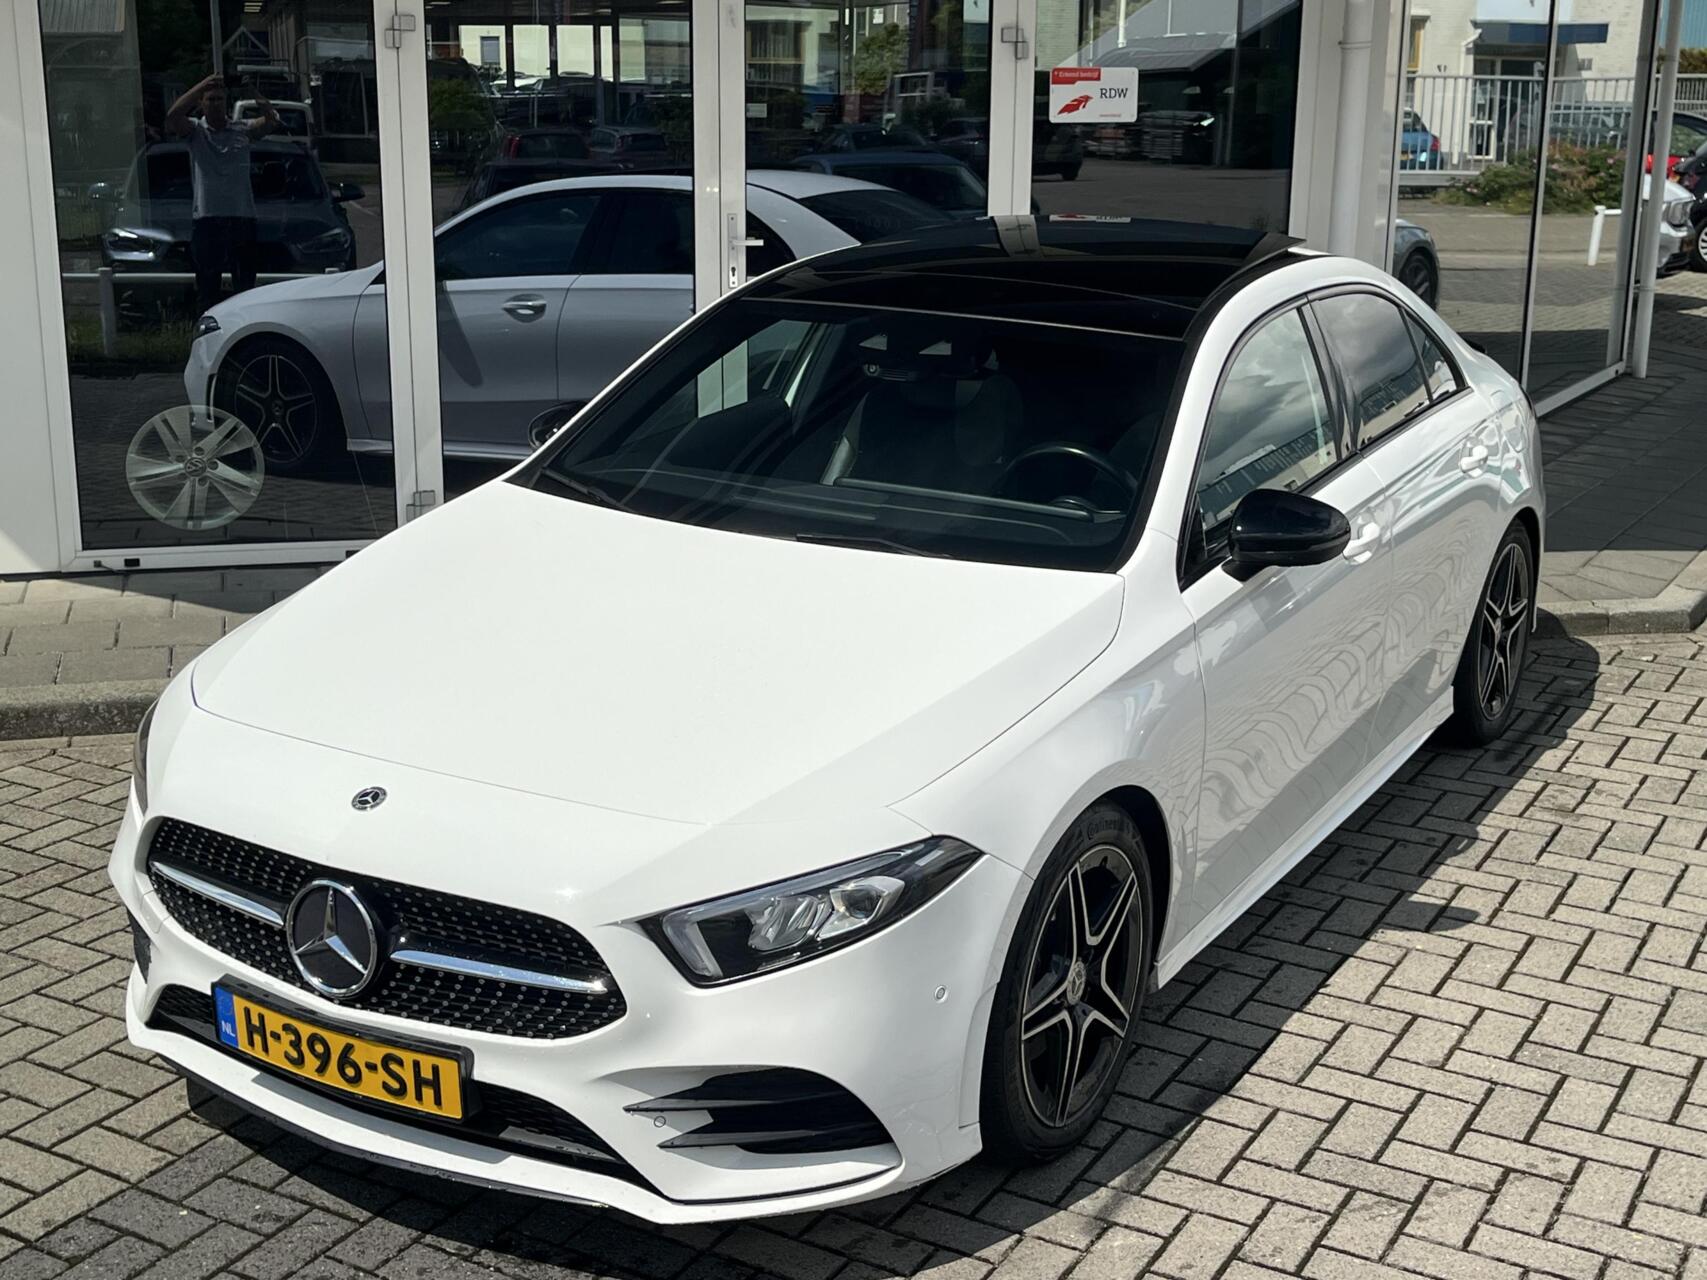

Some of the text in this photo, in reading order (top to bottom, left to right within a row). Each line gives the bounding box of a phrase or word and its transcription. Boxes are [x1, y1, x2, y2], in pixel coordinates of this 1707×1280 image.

[1100, 88, 1128, 99] RDW
[221, 1020, 236, 1037] NL
[243, 1006, 442, 1108] H-396-SH
